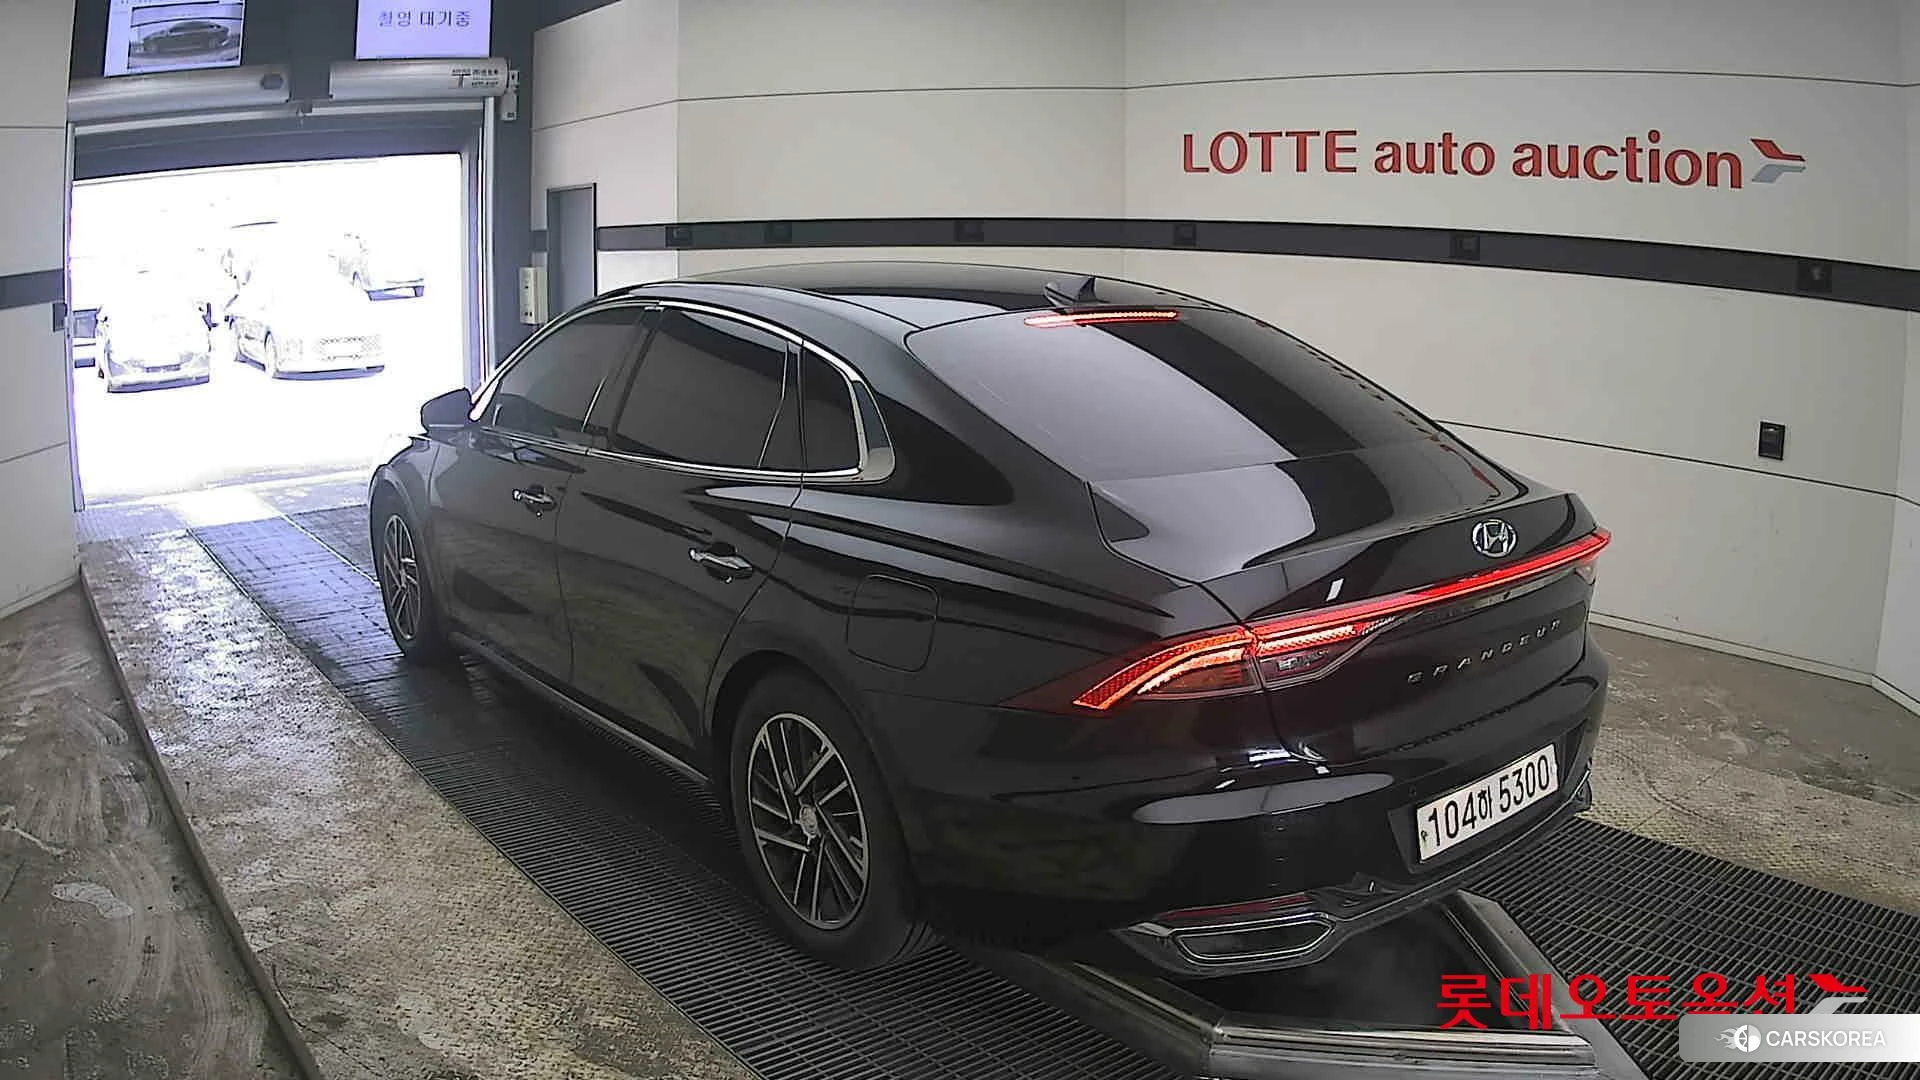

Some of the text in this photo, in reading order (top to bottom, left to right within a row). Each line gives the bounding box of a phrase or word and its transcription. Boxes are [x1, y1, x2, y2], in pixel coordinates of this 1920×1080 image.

[420, 9, 472, 28] 대기중
[1183, 129, 1744, 189] LOTTE auto auction
[1407, 618, 1561, 684] GRANDEUR
[1428, 754, 1550, 847] 104하 5300
